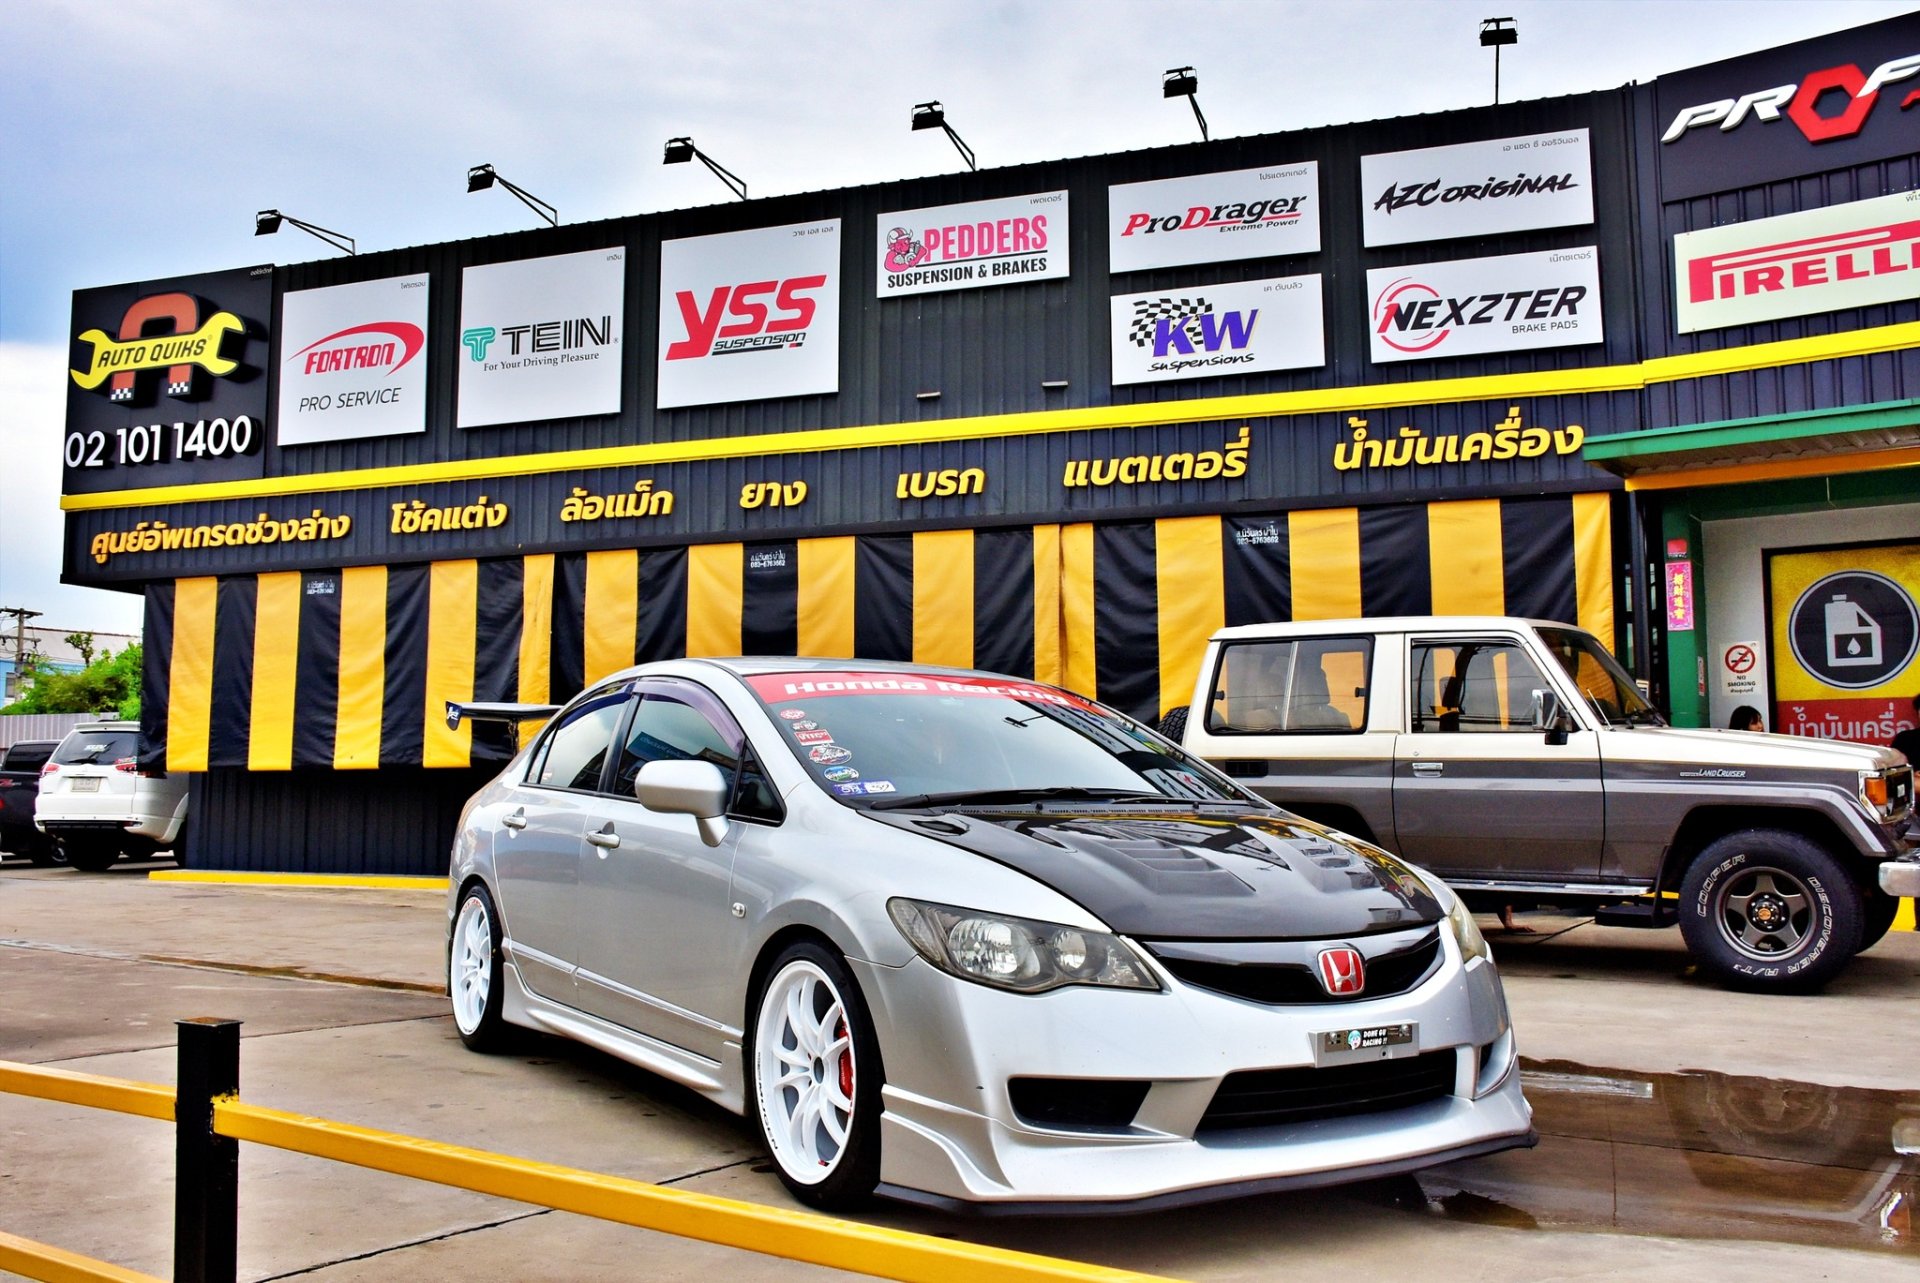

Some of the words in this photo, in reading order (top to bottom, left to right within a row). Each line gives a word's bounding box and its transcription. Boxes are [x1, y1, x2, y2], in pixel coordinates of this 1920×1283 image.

[1373, 178, 1440, 215] AZC
[1120, 194, 1308, 237] ProDrager
[1219, 221, 1262, 234] Extreme
[1266, 218, 1299, 229] Power
[924, 214, 1048, 263] PEDDERS
[887, 265, 974, 289] SUSPENSION
[978, 263, 988, 278] &
[992, 257, 1048, 276] BRAKES
[665, 274, 827, 361] YSS
[1377, 286, 1587, 334] NEXZTER
[1511, 322, 1547, 334] BRAKE
[1550, 320, 1578, 331] PADS
[502, 315, 612, 355] TEIN
[714, 332, 806, 350] SUSPENSION
[1153, 308, 1259, 358] KW
[97, 346, 146, 369] AUTO
[149, 338, 207, 363] QUIKS
[304, 342, 396, 376] FORTRON
[483, 362, 498, 372] For
[500, 360, 522, 370] Your
[523, 355, 558, 368] Driving
[560, 350, 600, 364] Pleasure
[298, 394, 332, 412] PRO
[336, 387, 402, 409] SERVICE
[65, 430, 106, 468] 02
[116, 424, 162, 465] 101
[173, 415, 252, 459] 1400
[1333, 406, 1585, 471] น้ำมันเครื่อง
[1063, 427, 1251, 488] แบตเตอรี่
[560, 480, 674, 522] ล้อแม็ก
[739, 478, 808, 509] ยาง
[896, 466, 986, 499] เบรก
[390, 501, 508, 534] โช้คแต่ง
[90, 513, 351, 565] ศูนย์อัพเกรดช่วงล่าง
[784, 680, 928, 696] Honda
[940, 682, 1070, 706] Racing
[1717, 769, 1746, 778] CRUISER
[1697, 854, 1746, 917] COOPER
[1788, 876, 1833, 974] DISCOVERER
